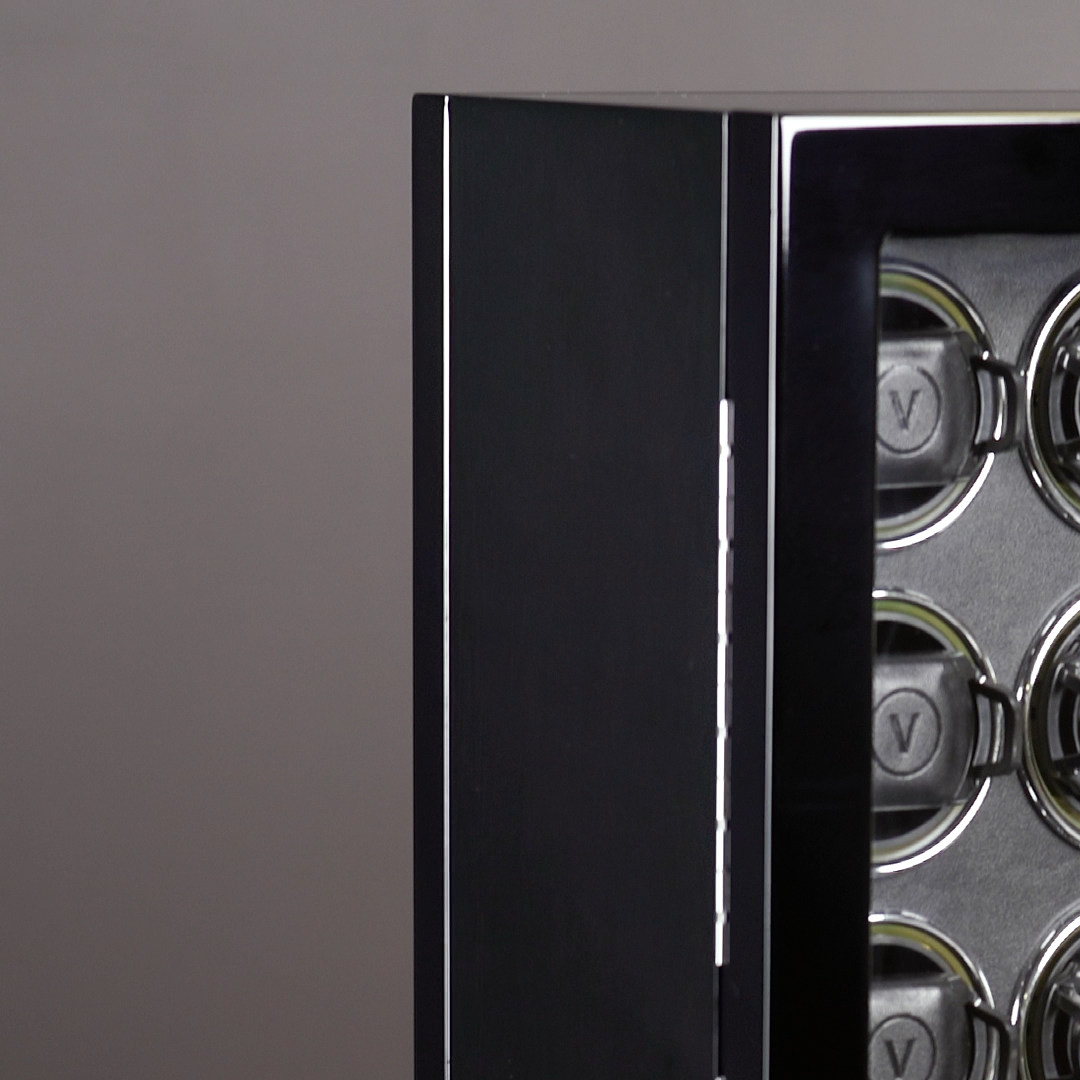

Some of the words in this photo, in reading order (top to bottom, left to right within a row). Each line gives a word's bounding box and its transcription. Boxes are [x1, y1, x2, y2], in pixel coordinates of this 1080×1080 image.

[889, 390, 921, 429] V
[889, 713, 921, 753] V
[884, 1038, 916, 1078] V
